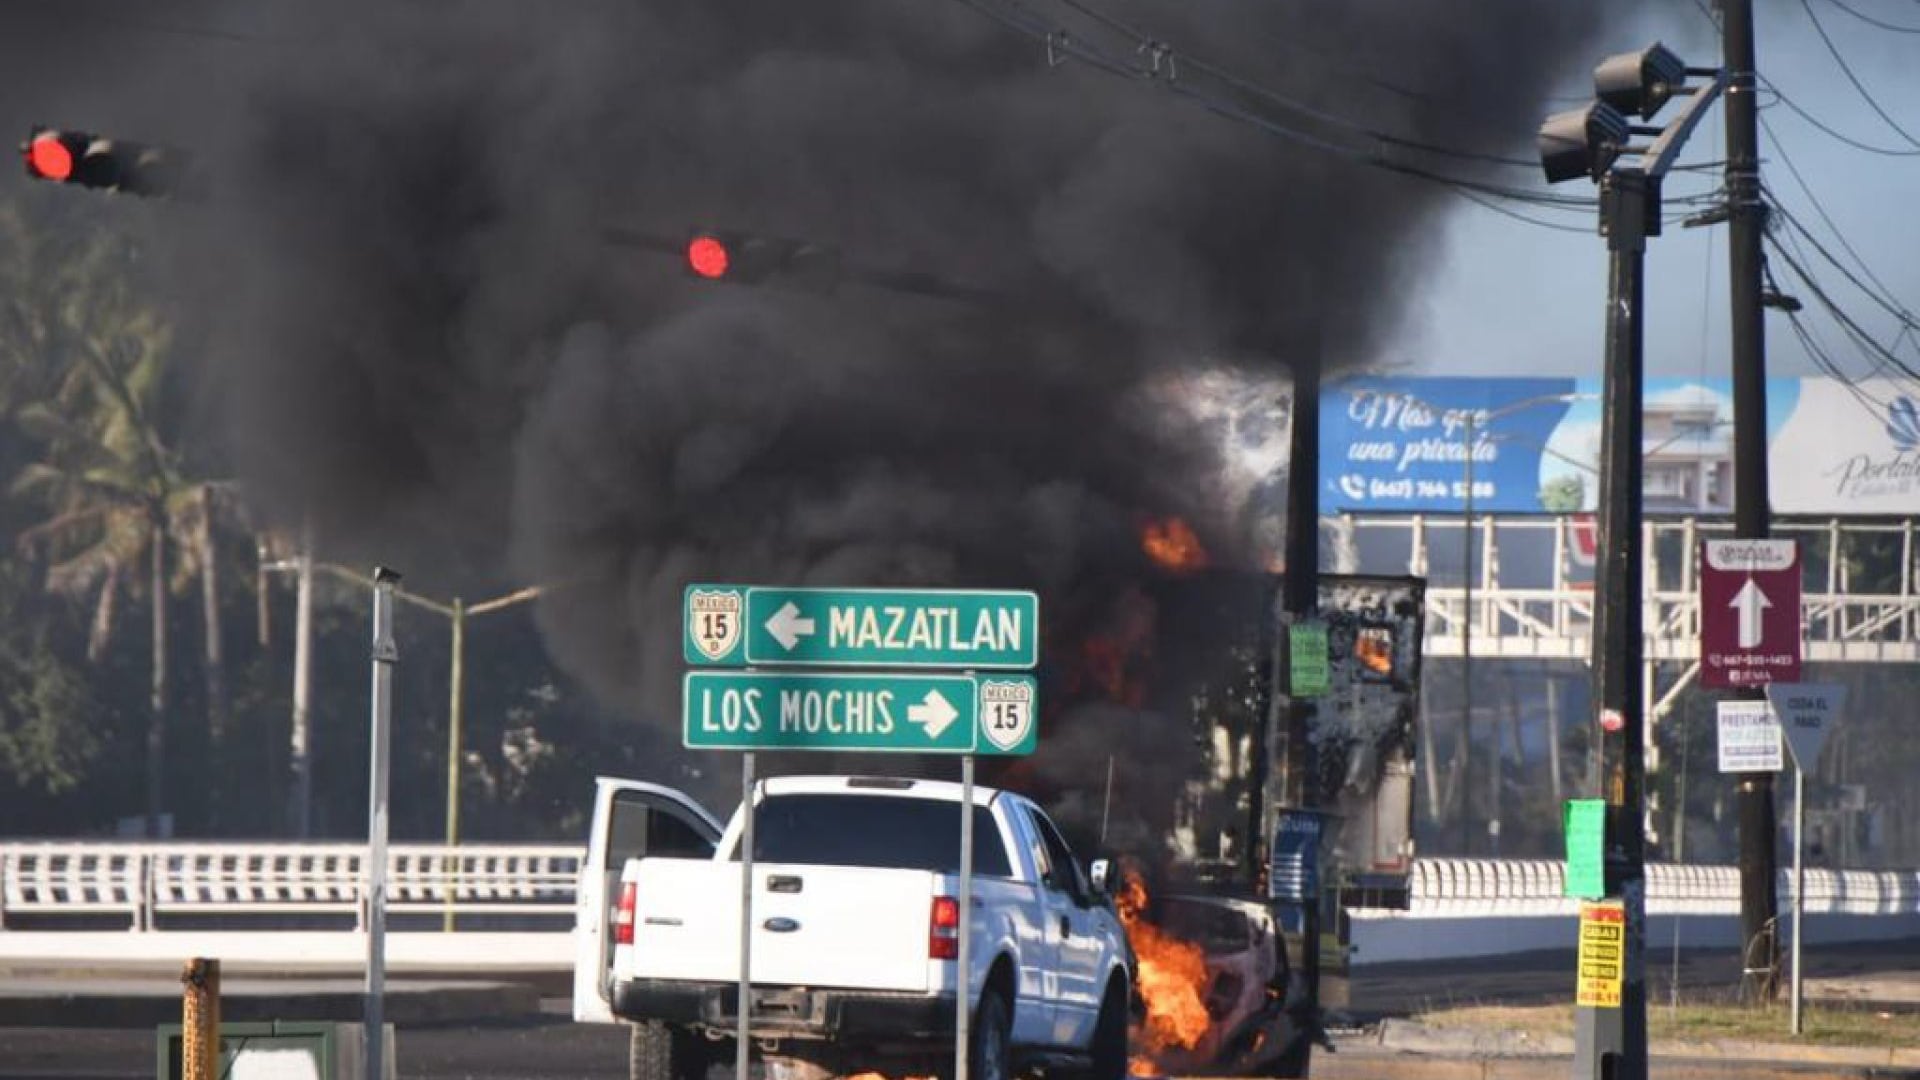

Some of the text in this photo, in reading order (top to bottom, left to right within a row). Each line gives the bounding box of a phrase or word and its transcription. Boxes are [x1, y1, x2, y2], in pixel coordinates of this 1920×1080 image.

[1348, 431, 1498, 473] una privada
[696, 597, 736, 609] MEXICO
[702, 613, 728, 639] 15
[828, 606, 1022, 651] MAZATLAN
[987, 687, 1026, 699] MEXICO
[702, 688, 895, 734] LOS MOCHIS
[993, 703, 1018, 729] 15
